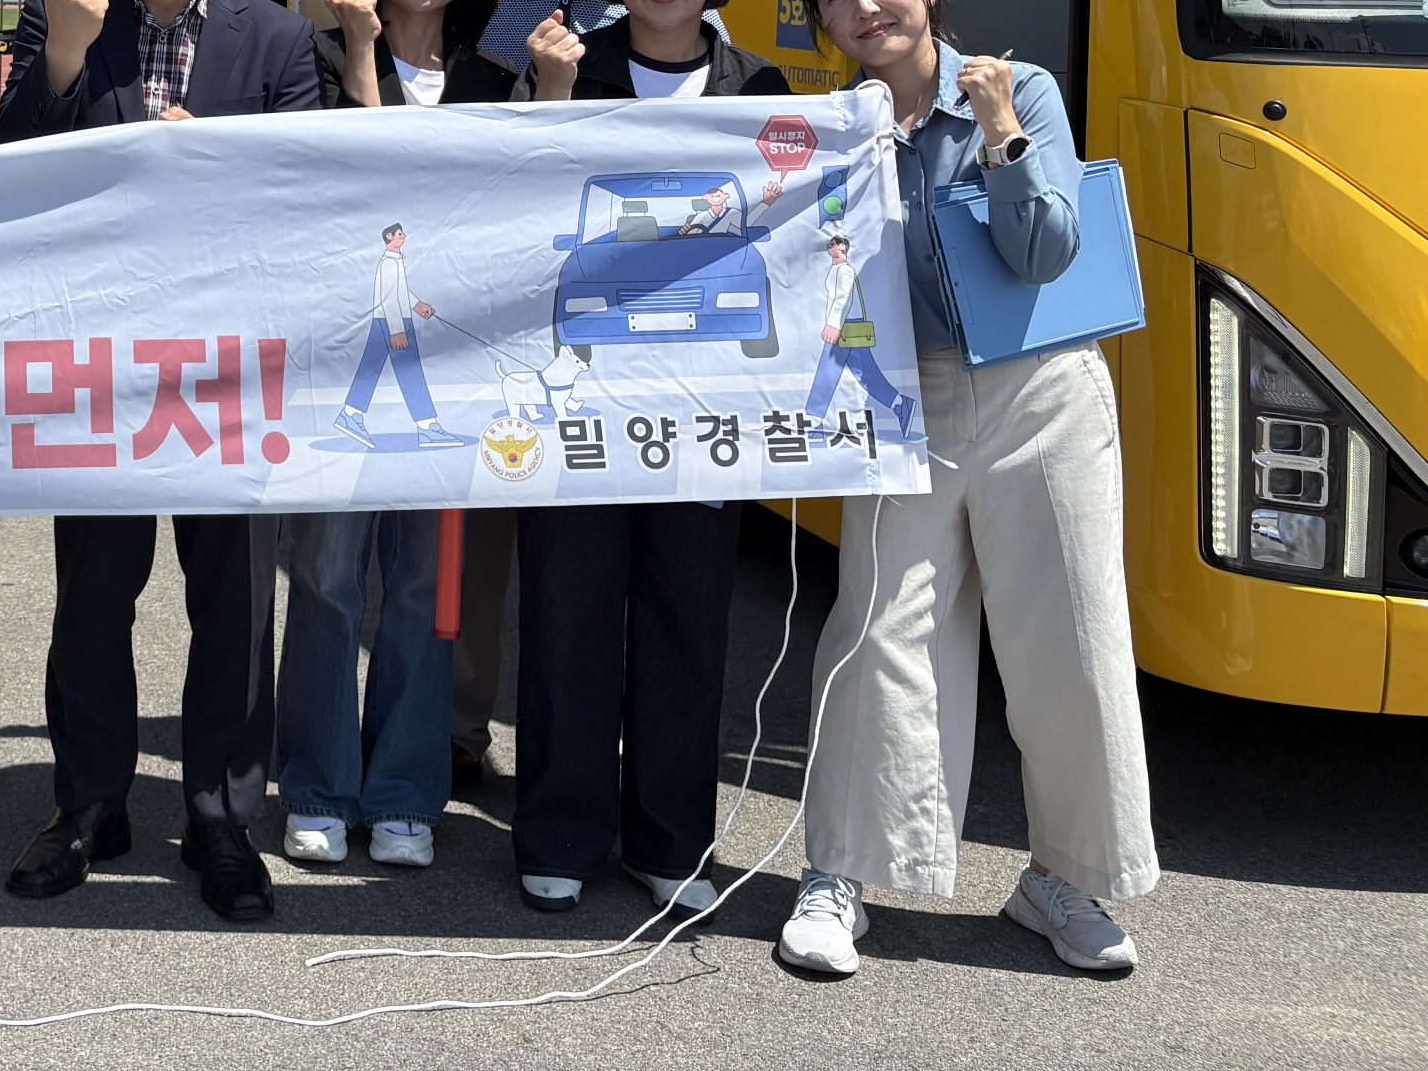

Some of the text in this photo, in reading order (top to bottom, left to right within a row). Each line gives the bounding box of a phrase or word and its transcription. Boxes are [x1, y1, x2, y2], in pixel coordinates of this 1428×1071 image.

[768, 131, 806, 142] 일시정지
[769, 142, 806, 155] STOP
[4, 334, 292, 470] 먼저!
[557, 409, 878, 470] 밀양경찰서
[504, 469, 528, 479] POLICE
[527, 446, 542, 473] AGENCY
